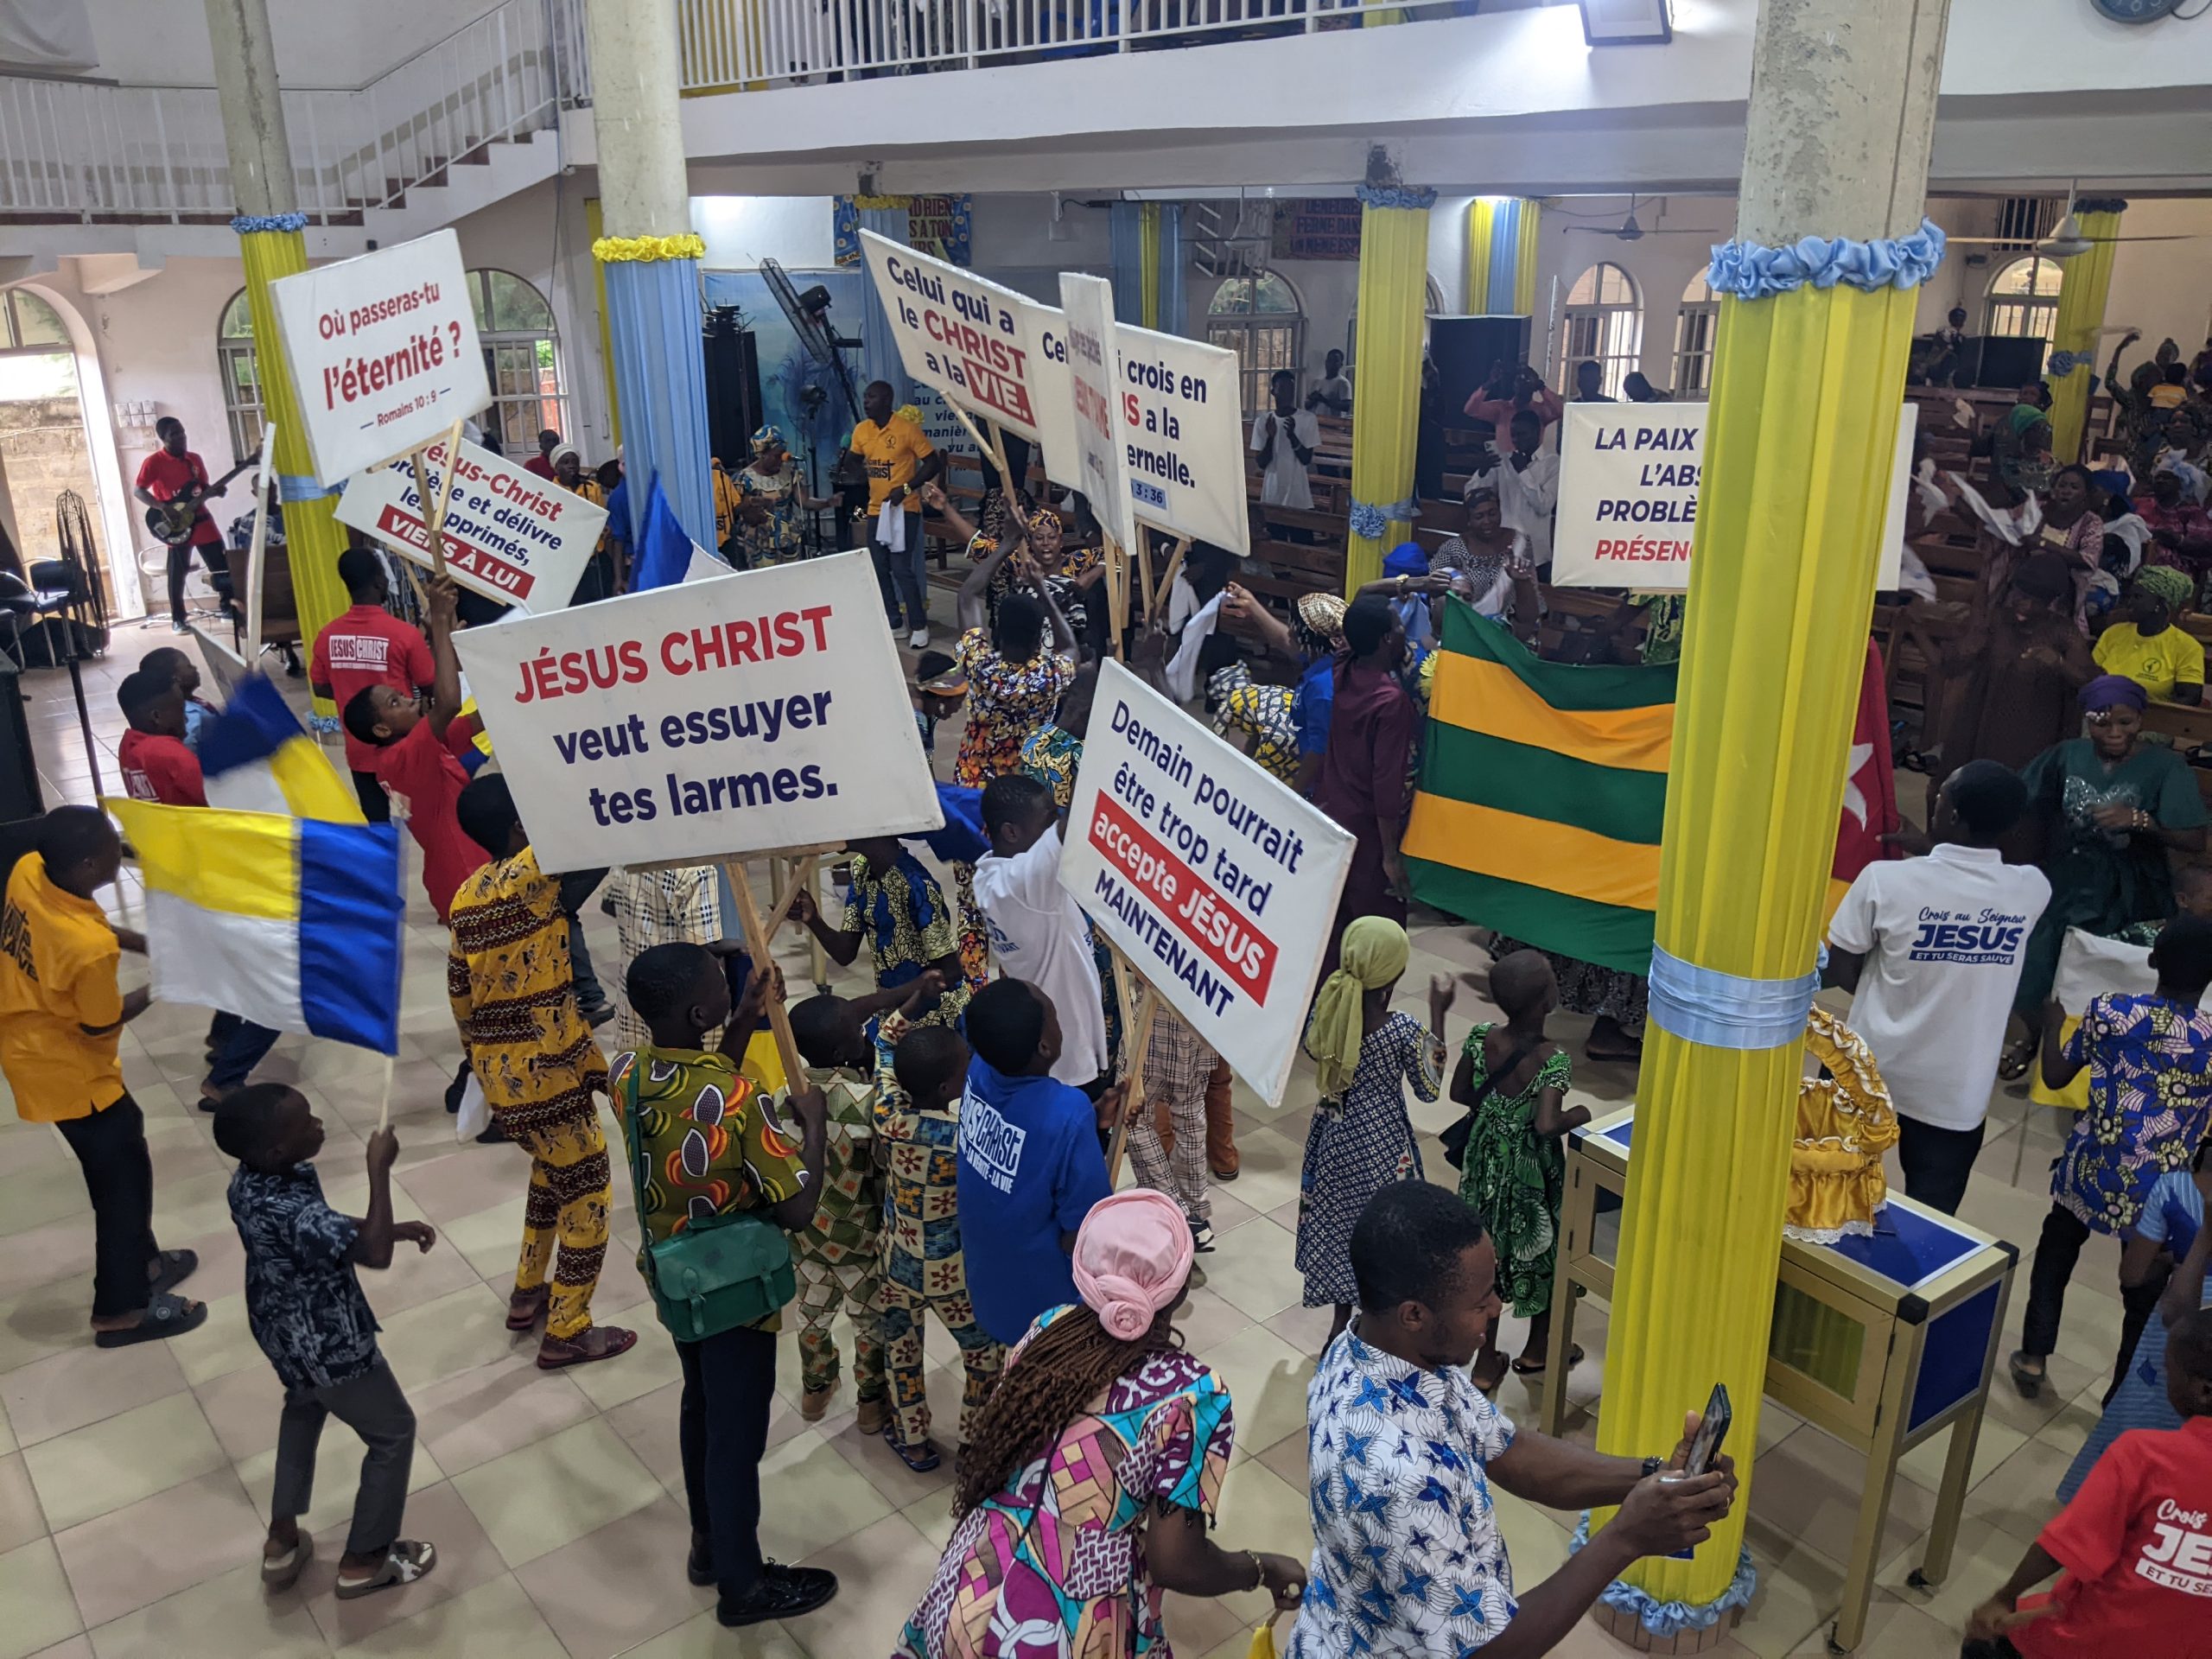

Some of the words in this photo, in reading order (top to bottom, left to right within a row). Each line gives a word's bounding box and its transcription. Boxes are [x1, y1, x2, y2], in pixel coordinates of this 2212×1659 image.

[319, 308, 346, 340] Où
[350, 281, 441, 337] passeras-tu
[887, 257, 945, 305] Celui
[951, 289, 992, 325] qui
[1000, 309, 1015, 335] a
[898, 296, 919, 330] le
[924, 309, 1027, 379] CHRIST
[322, 324, 443, 410] l'éternité
[925, 352, 941, 374] a
[942, 355, 967, 387] la
[968, 365, 1030, 419] VIE.
[1043, 332, 1069, 365] Cel
[1128, 359, 1174, 394] crois
[1180, 375, 1207, 404] en
[377, 402, 414, 427] Romains
[923, 426, 969, 438] manièr
[1146, 408, 1157, 433] a
[1163, 407, 1179, 442] la
[1594, 428, 1627, 450] LA
[1634, 428, 1700, 450] PAIX
[421, 442, 563, 522] éus-Christ
[1127, 444, 1195, 488] ernelle.
[468, 494, 492, 516] et
[493, 506, 562, 550] délivre
[1150, 488, 1163, 504] 36
[1596, 495, 1698, 522] PROBLÈ
[399, 486, 423, 512] le
[442, 508, 530, 567] pprimés,
[1594, 534, 1694, 562] PRÉSEN
[458, 551, 477, 571] À
[480, 564, 521, 591] LUI
[513, 640, 648, 704] JÉSUS
[661, 605, 832, 676] CHRIST
[552, 714, 649, 765] veut
[660, 690, 832, 748] essuyer
[589, 787, 657, 826] tes
[666, 764, 838, 817] larmes.
[1110, 699, 1193, 789] Demain
[1193, 772, 1304, 874] pourrait
[1114, 762, 1155, 819] être
[1159, 811, 1210, 867] trop
[1212, 847, 1273, 918] tard
[1093, 810, 1178, 903] accepte
[1178, 893, 1265, 982] JÉSUS
[1918, 906, 1950, 922] Crois
[1955, 912, 1971, 921] au
[1977, 907, 2026, 925] Seigneur
[1095, 868, 1236, 1020] MAINTENANT
[1911, 924, 2024, 951] JESUS
[1947, 952, 1980, 963] SERAS
[2157, 1498, 2208, 1529] Crois
[2142, 1522, 2212, 1576] JE
[2146, 1565, 2165, 1580] ET
[2168, 1574, 2190, 1588] TU
[2193, 1582, 2212, 1594] SE
